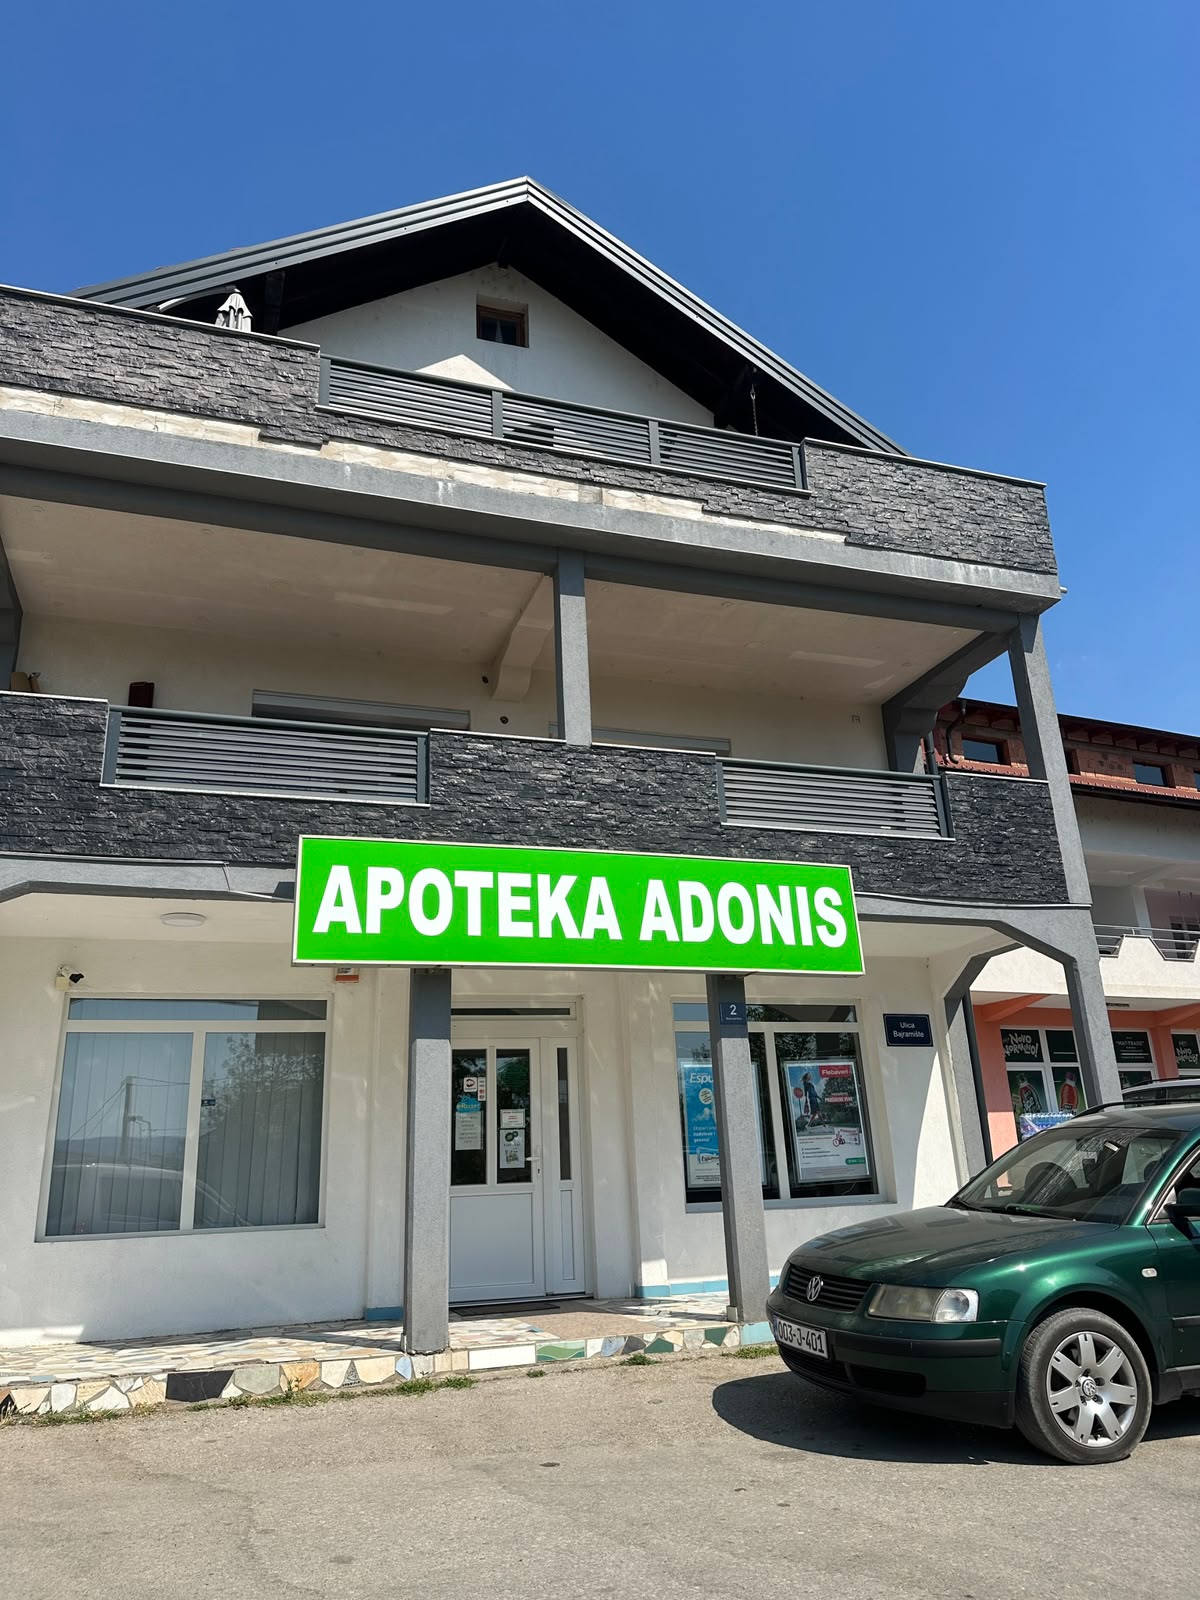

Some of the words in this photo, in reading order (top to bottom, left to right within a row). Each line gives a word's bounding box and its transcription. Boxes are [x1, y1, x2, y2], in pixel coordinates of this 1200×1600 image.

[312, 864, 622, 941] APOTEKA
[638, 878, 848, 948] ADONIS
[729, 1004, 737, 1015] 2
[899, 1021, 915, 1029] Ulica
